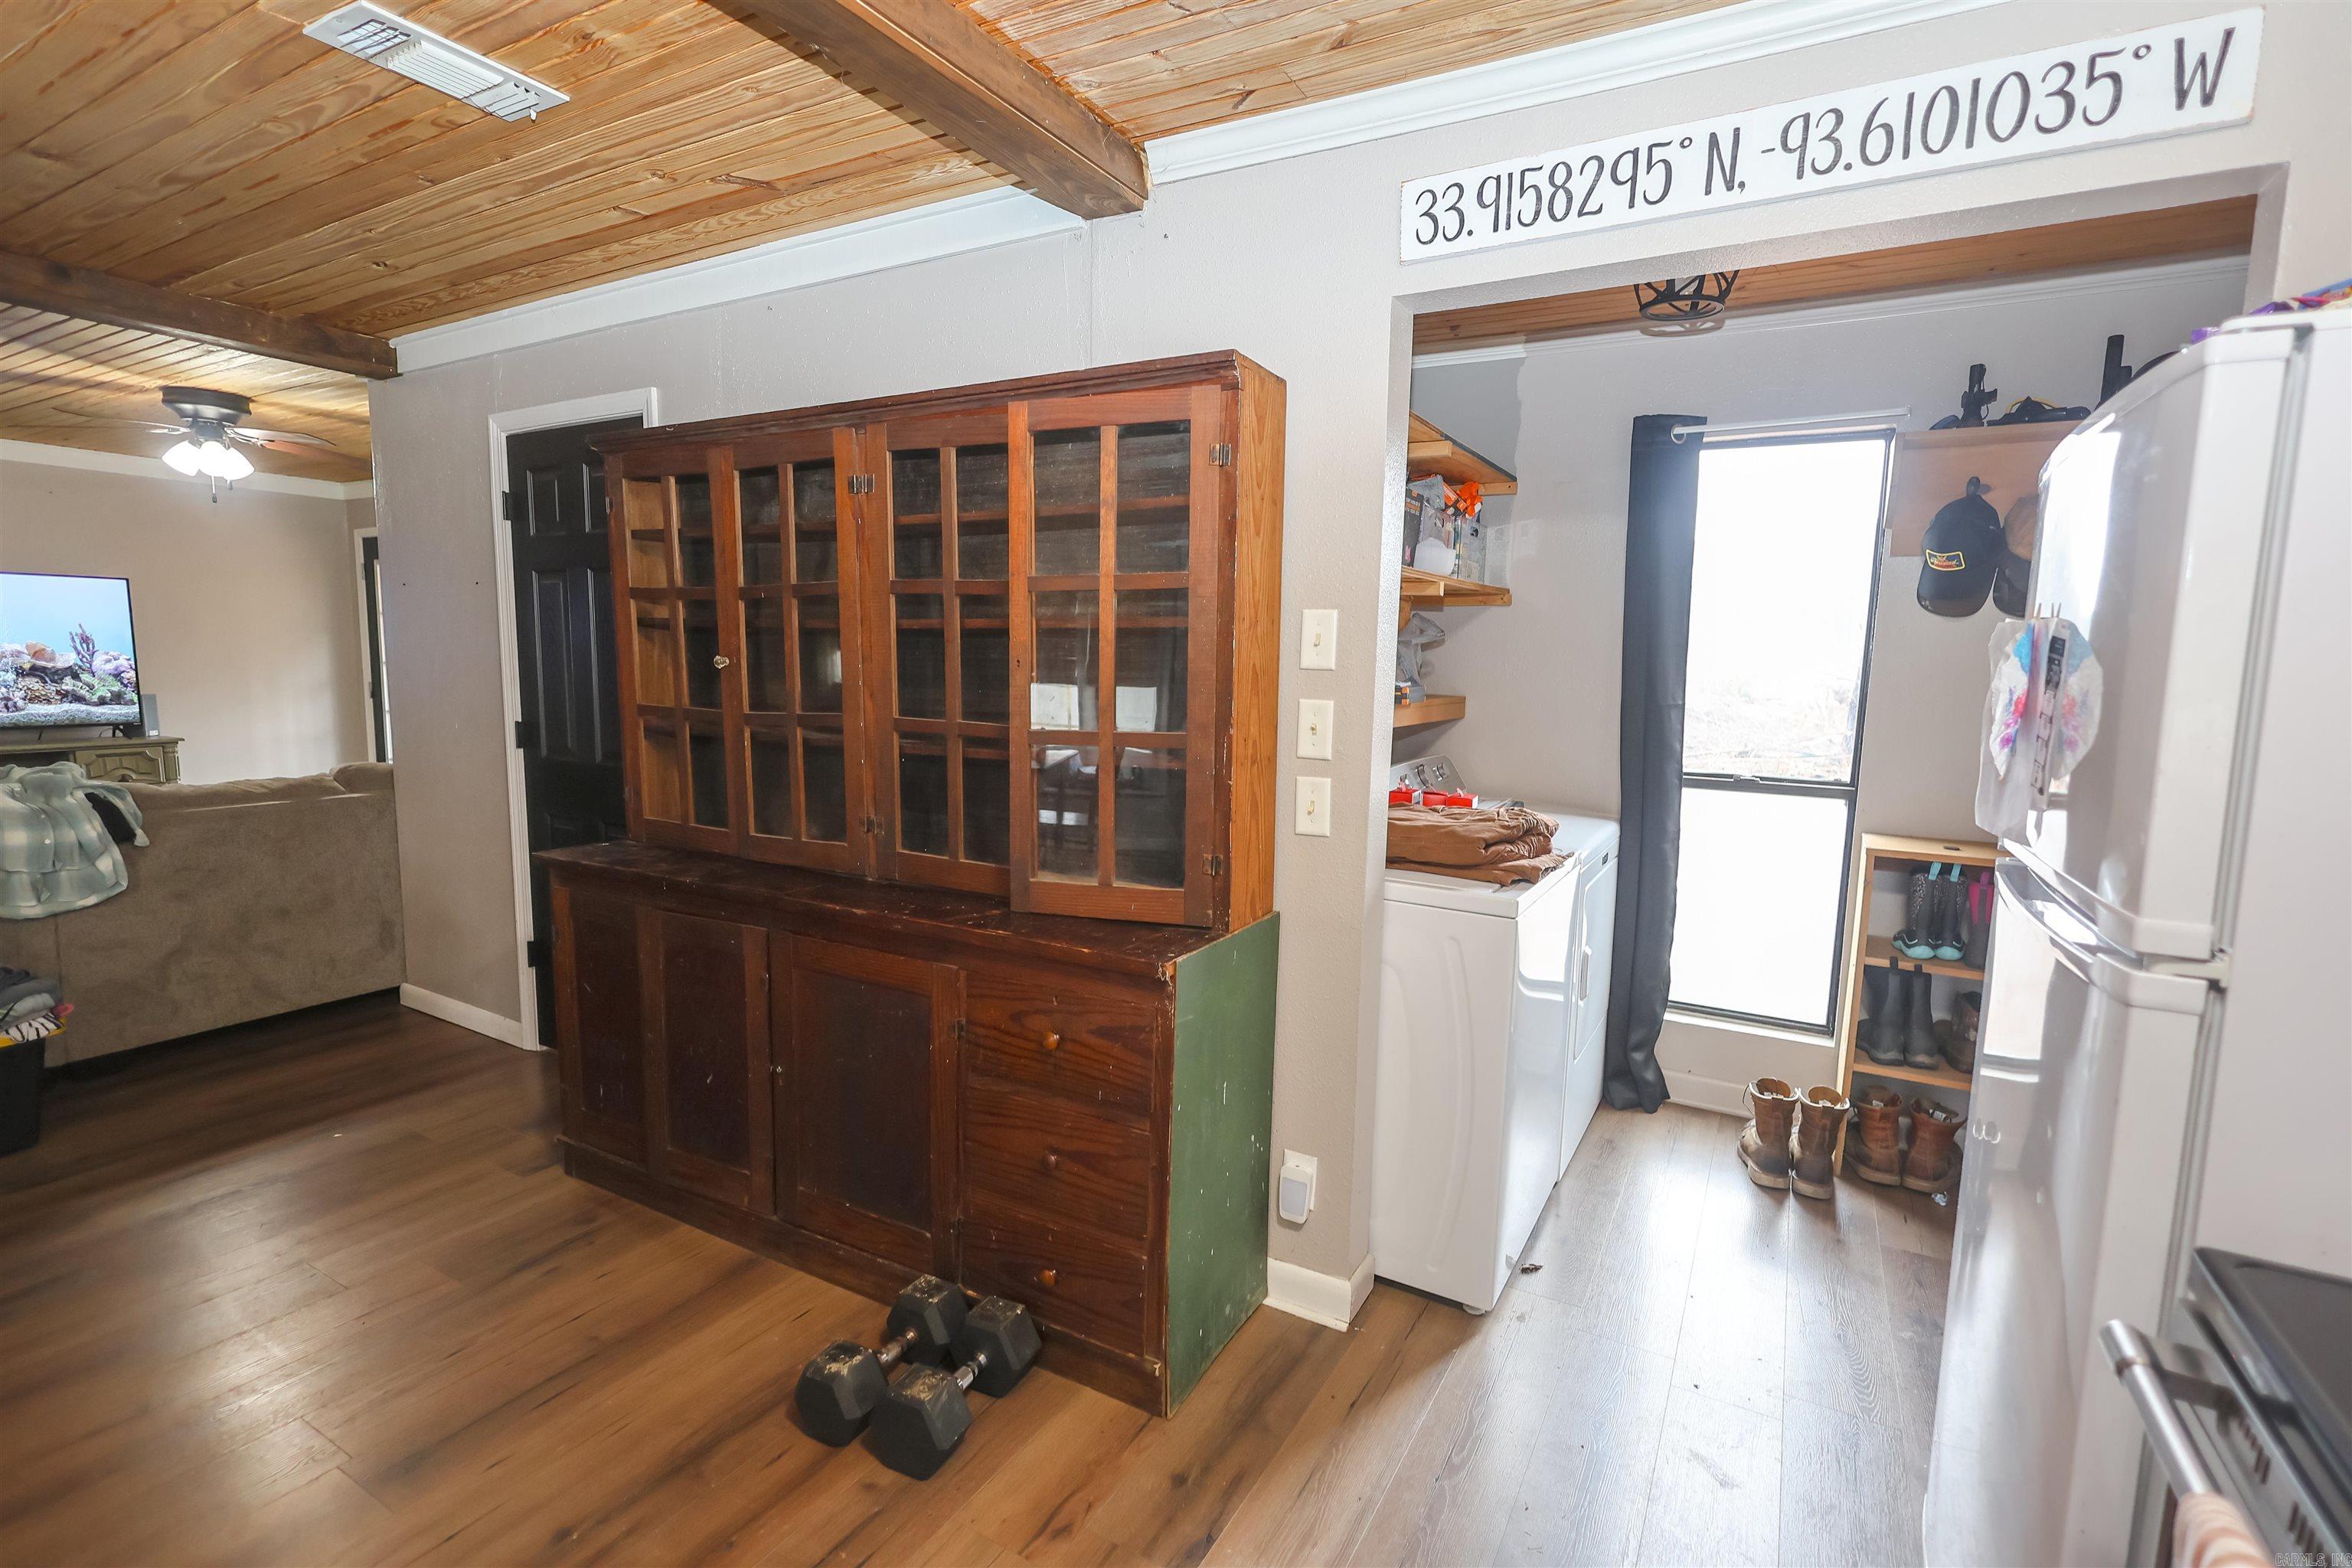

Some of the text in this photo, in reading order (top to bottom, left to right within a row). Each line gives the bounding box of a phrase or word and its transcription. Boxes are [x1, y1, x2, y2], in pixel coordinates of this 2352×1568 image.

[1415, 28, 2235, 245] 33.9158295° N, -93.6101035° W
